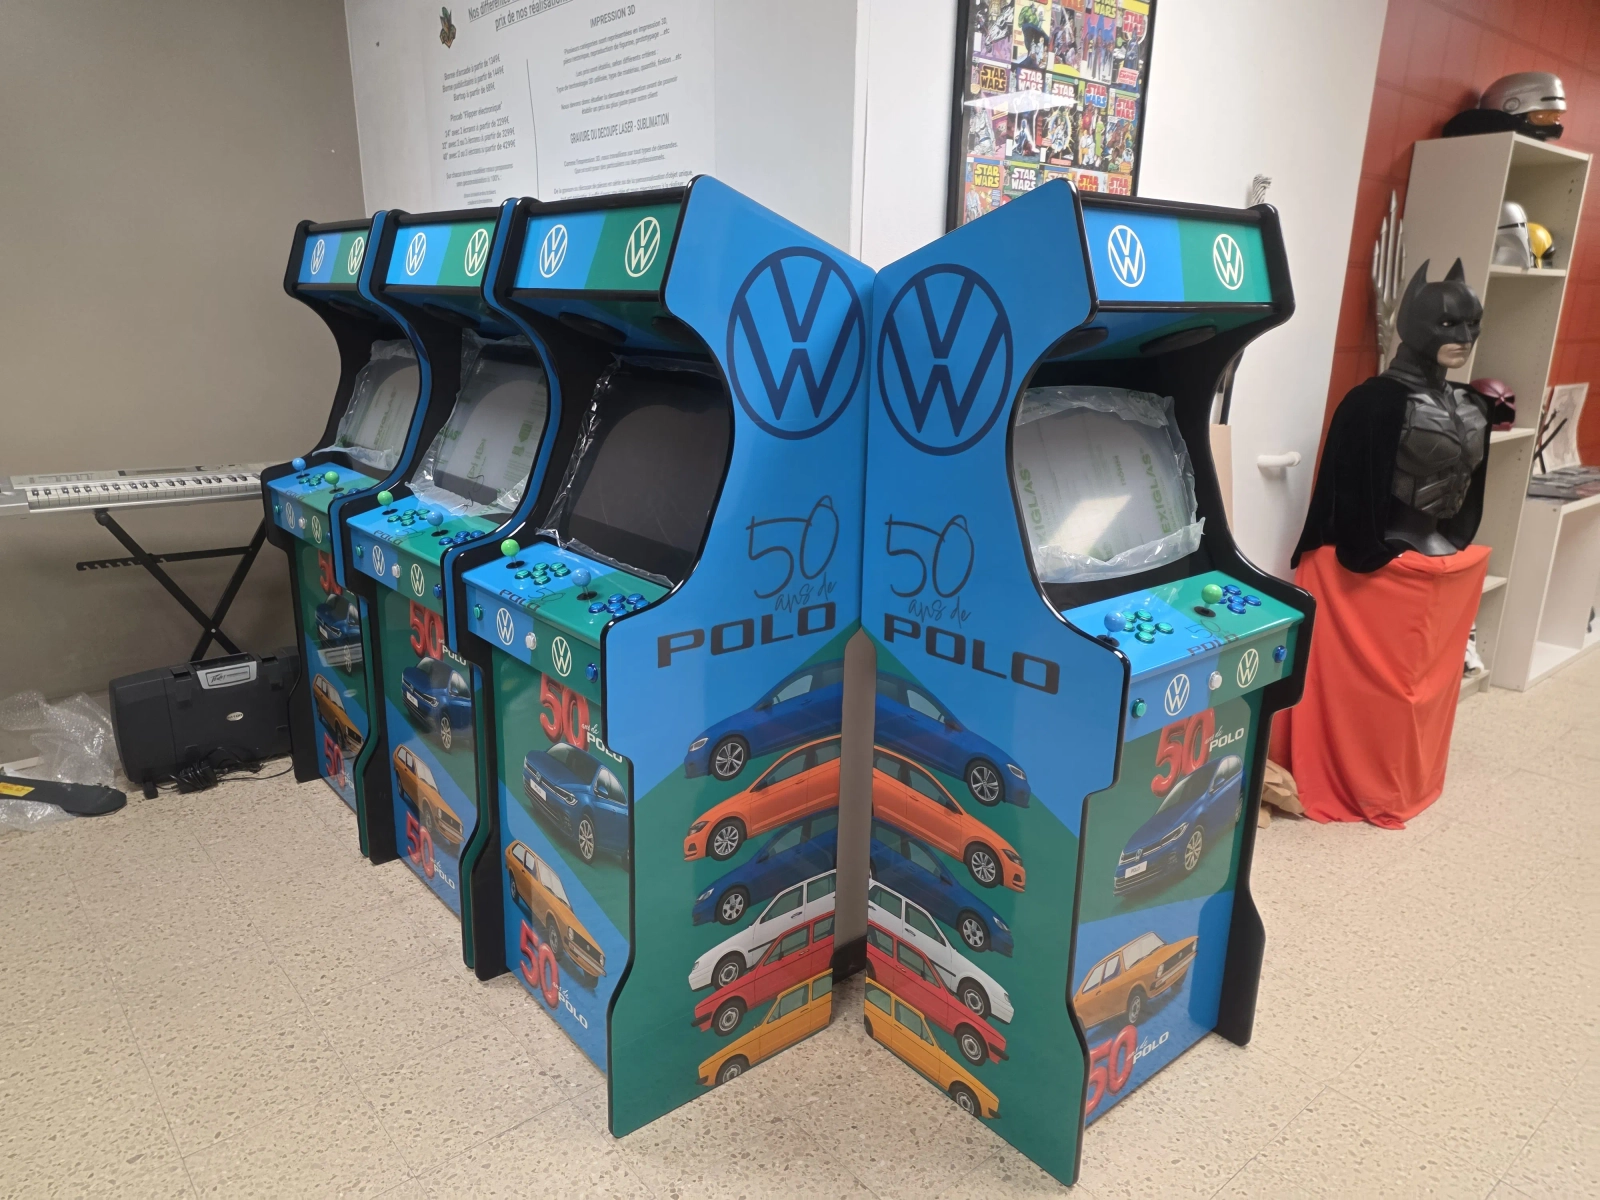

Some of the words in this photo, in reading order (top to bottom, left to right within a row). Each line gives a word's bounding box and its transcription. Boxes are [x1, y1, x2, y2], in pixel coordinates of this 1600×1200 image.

[468, 7, 479, 20] Nos
[494, 14, 506, 31] prix
[508, 10, 515, 23] de
[516, 6, 528, 20] nos
[590, 7, 626, 28] IMPRESSION
[627, 4, 635, 16] 3D
[1094, 2, 1116, 19] WARS
[1123, 11, 1144, 24] STAR
[484, 58, 488, 68] de
[488, 70, 492, 79] de
[981, 66, 1006, 80] STAR
[1019, 68, 1043, 83] STAR
[481, 85, 485, 94] de
[981, 76, 1005, 91] WARS
[1019, 81, 1042, 91] WARS
[1051, 83, 1075, 97] STAR
[1086, 83, 1107, 98] STAR
[1085, 94, 1107, 108] WARS
[1116, 98, 1136, 111] STAR
[491, 120, 496, 128] de
[1116, 108, 1136, 121] WARS
[570, 129, 590, 144] GRAVURE
[598, 123, 619, 139] DECOUPE
[619, 120, 633, 135] LASER
[637, 112, 670, 131] SUBLIMATION
[497, 142, 502, 150] de
[975, 164, 1000, 176] STAR
[1012, 168, 1036, 180] STAR
[974, 175, 1000, 188] WARS
[1012, 178, 1036, 190] WARS
[1079, 175, 1098, 186] STAR
[1110, 177, 1128, 188] STAR
[1142, 454, 1172, 534] EXIGLAS
[374, 530, 403, 545] POLO
[746, 494, 839, 598] 50
[885, 514, 974, 598] 50
[818, 572, 837, 601] de
[499, 589, 540, 612] POLO
[950, 596, 971, 628] de
[410, 600, 444, 661] 50
[658, 602, 836, 668] POLO
[884, 612, 1061, 695] POLO
[1187, 634, 1239, 656] POLO
[540, 672, 590, 751] 50
[587, 731, 623, 763] POLO
[1209, 728, 1244, 752] POLO
[324, 732, 345, 791] 50
[1151, 707, 1216, 798] 50
[406, 811, 434, 880] 50
[434, 863, 455, 889] POLO
[520, 919, 559, 1010] 50
[558, 992, 588, 1029] POLO
[1132, 1031, 1169, 1064] POLO
[1085, 1024, 1138, 1117] 50
